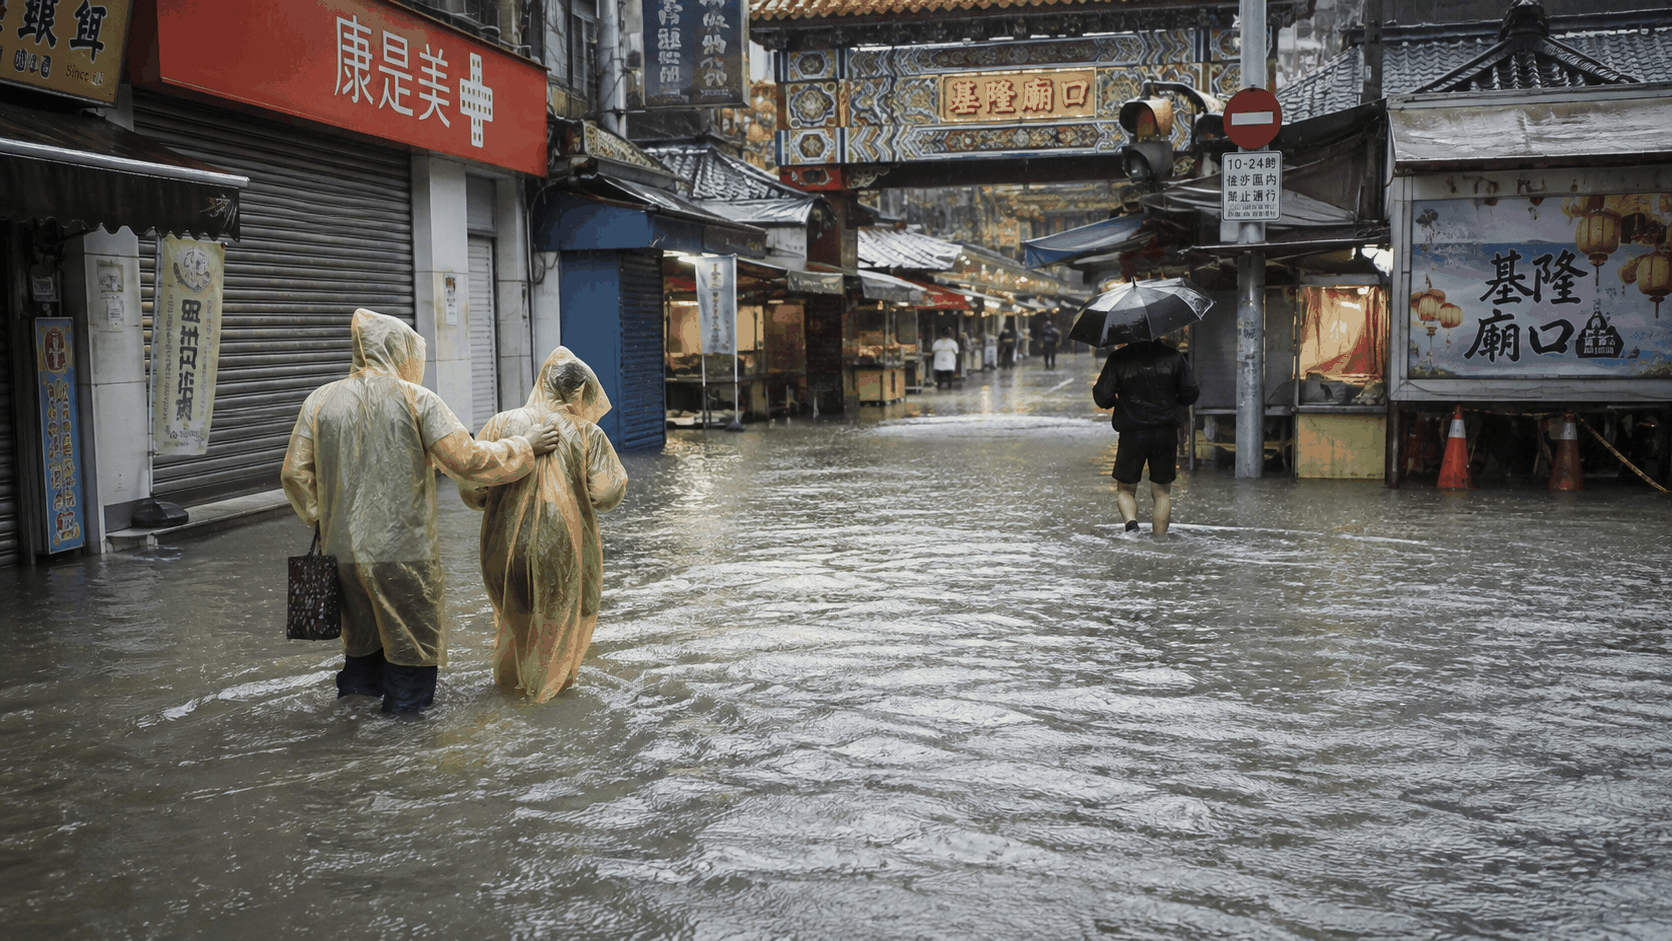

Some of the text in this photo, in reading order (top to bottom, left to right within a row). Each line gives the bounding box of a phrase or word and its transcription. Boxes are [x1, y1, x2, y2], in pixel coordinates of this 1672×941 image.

[334, 15, 450, 128] 康是美
[950, 79, 1090, 115] 基隆廟口
[1479, 248, 1588, 304] 基隆
[1464, 308, 1575, 362] 廟口
